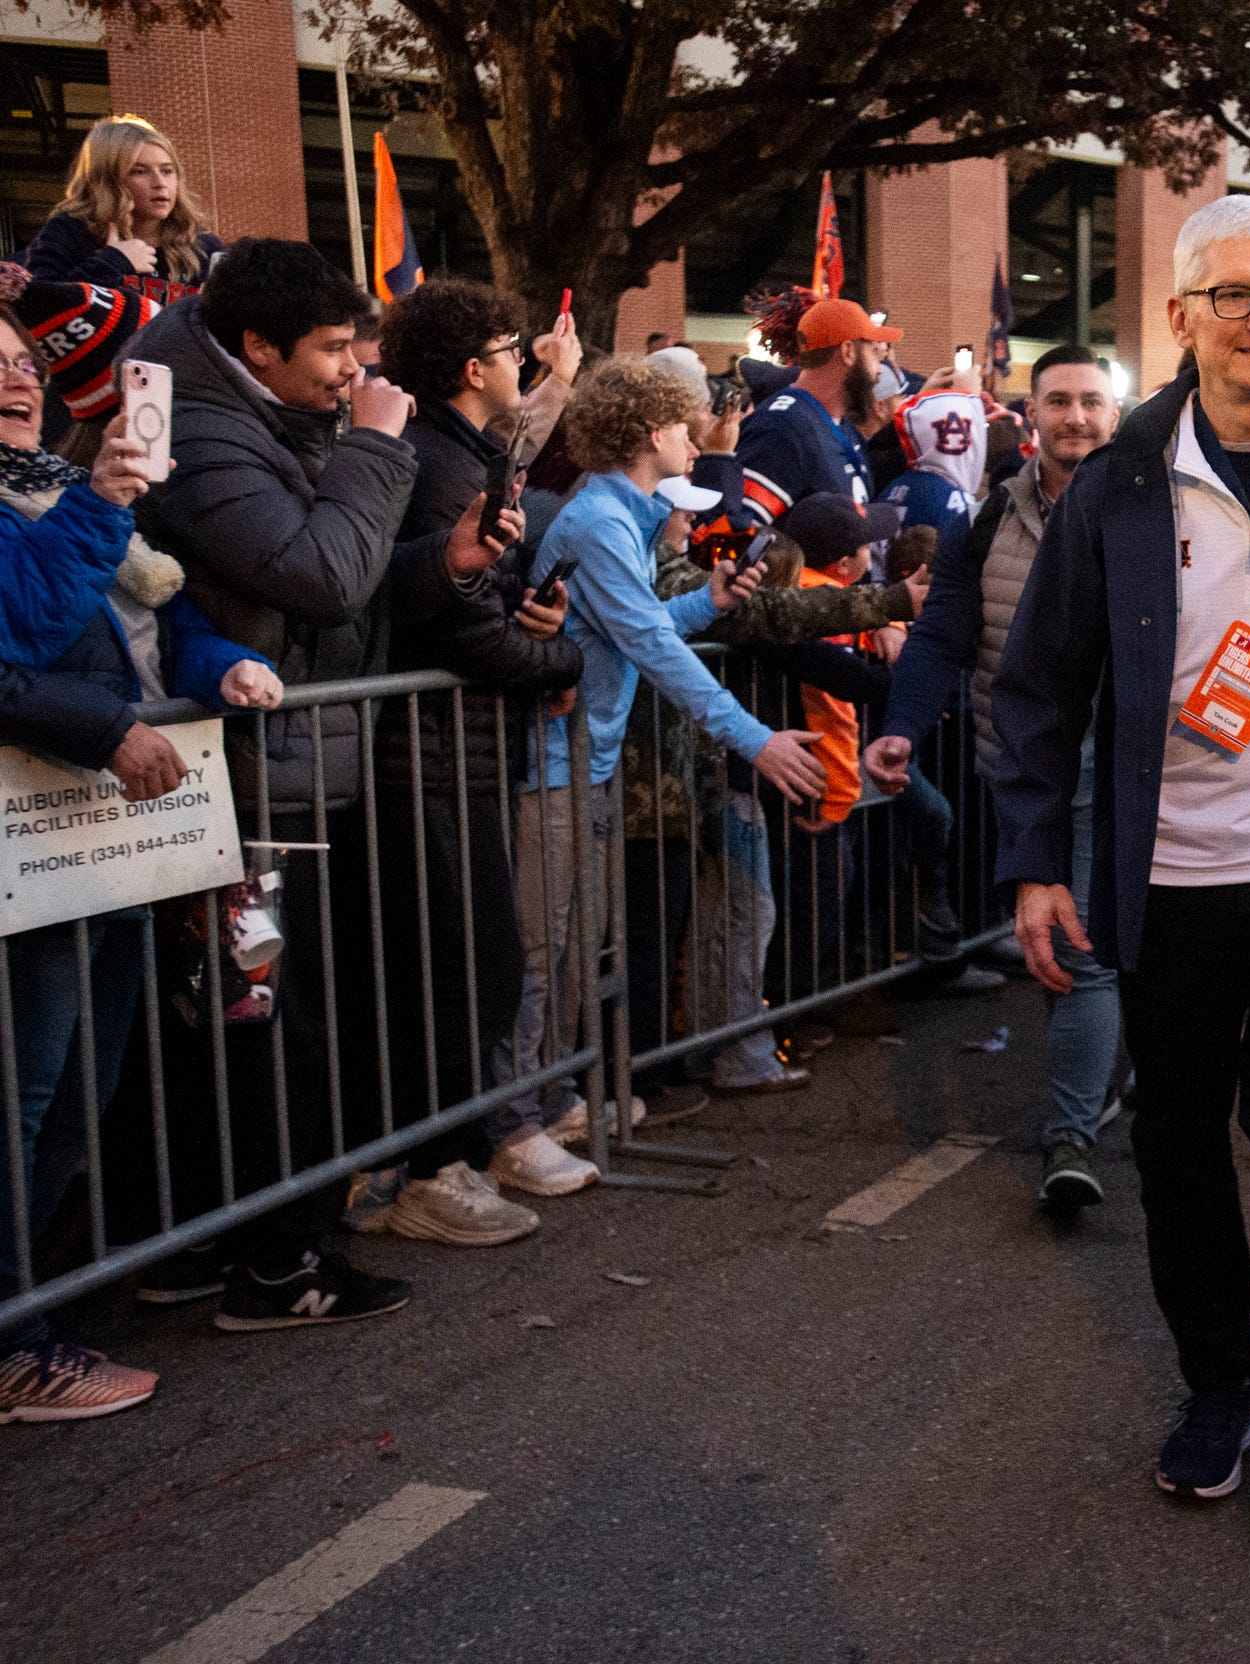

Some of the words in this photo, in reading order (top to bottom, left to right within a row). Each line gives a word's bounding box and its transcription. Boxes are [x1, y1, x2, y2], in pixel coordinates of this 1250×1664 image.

[4, 785, 91, 816] AUBURN
[5, 807, 120, 839] FACILITIES
[126, 791, 210, 818] DIVISION
[19, 851, 86, 876] PHONE
[91, 842, 132, 865] (334)
[136, 828, 206, 853] 844-4357
[290, 1288, 338, 1317] N
